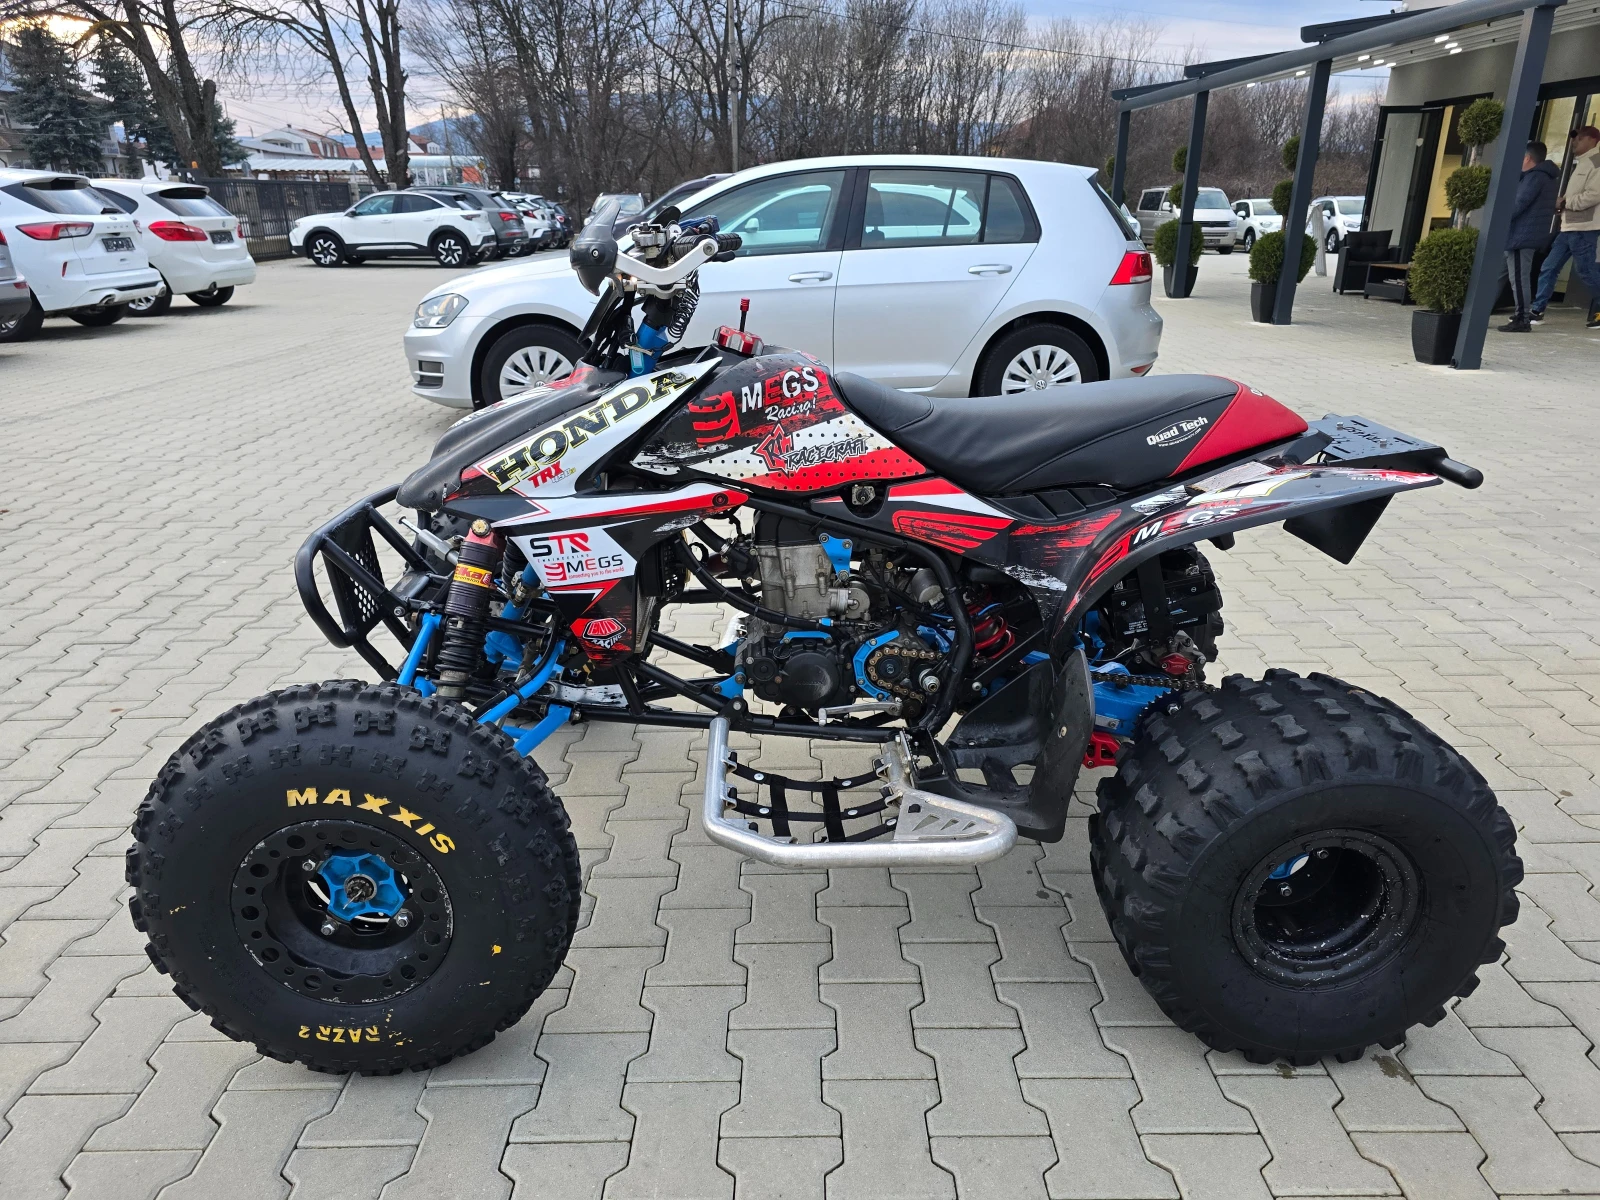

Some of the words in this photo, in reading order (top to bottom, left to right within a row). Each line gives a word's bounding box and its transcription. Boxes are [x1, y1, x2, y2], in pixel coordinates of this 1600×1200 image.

[741, 366, 819, 413] MEGS
[486, 371, 697, 493] HONDA
[1146, 426, 1180, 446] Quad
[1179, 416, 1209, 432] Tech
[783, 438, 868, 470] RACECRAFT
[527, 460, 564, 488] TRX
[529, 532, 593, 558] STR
[566, 553, 624, 574] MEGS
[591, 634, 623, 650] RACING
[286, 786, 457, 854] MAXXIS
[298, 1025, 311, 1039] 2
[315, 1025, 380, 1044] RAZR
